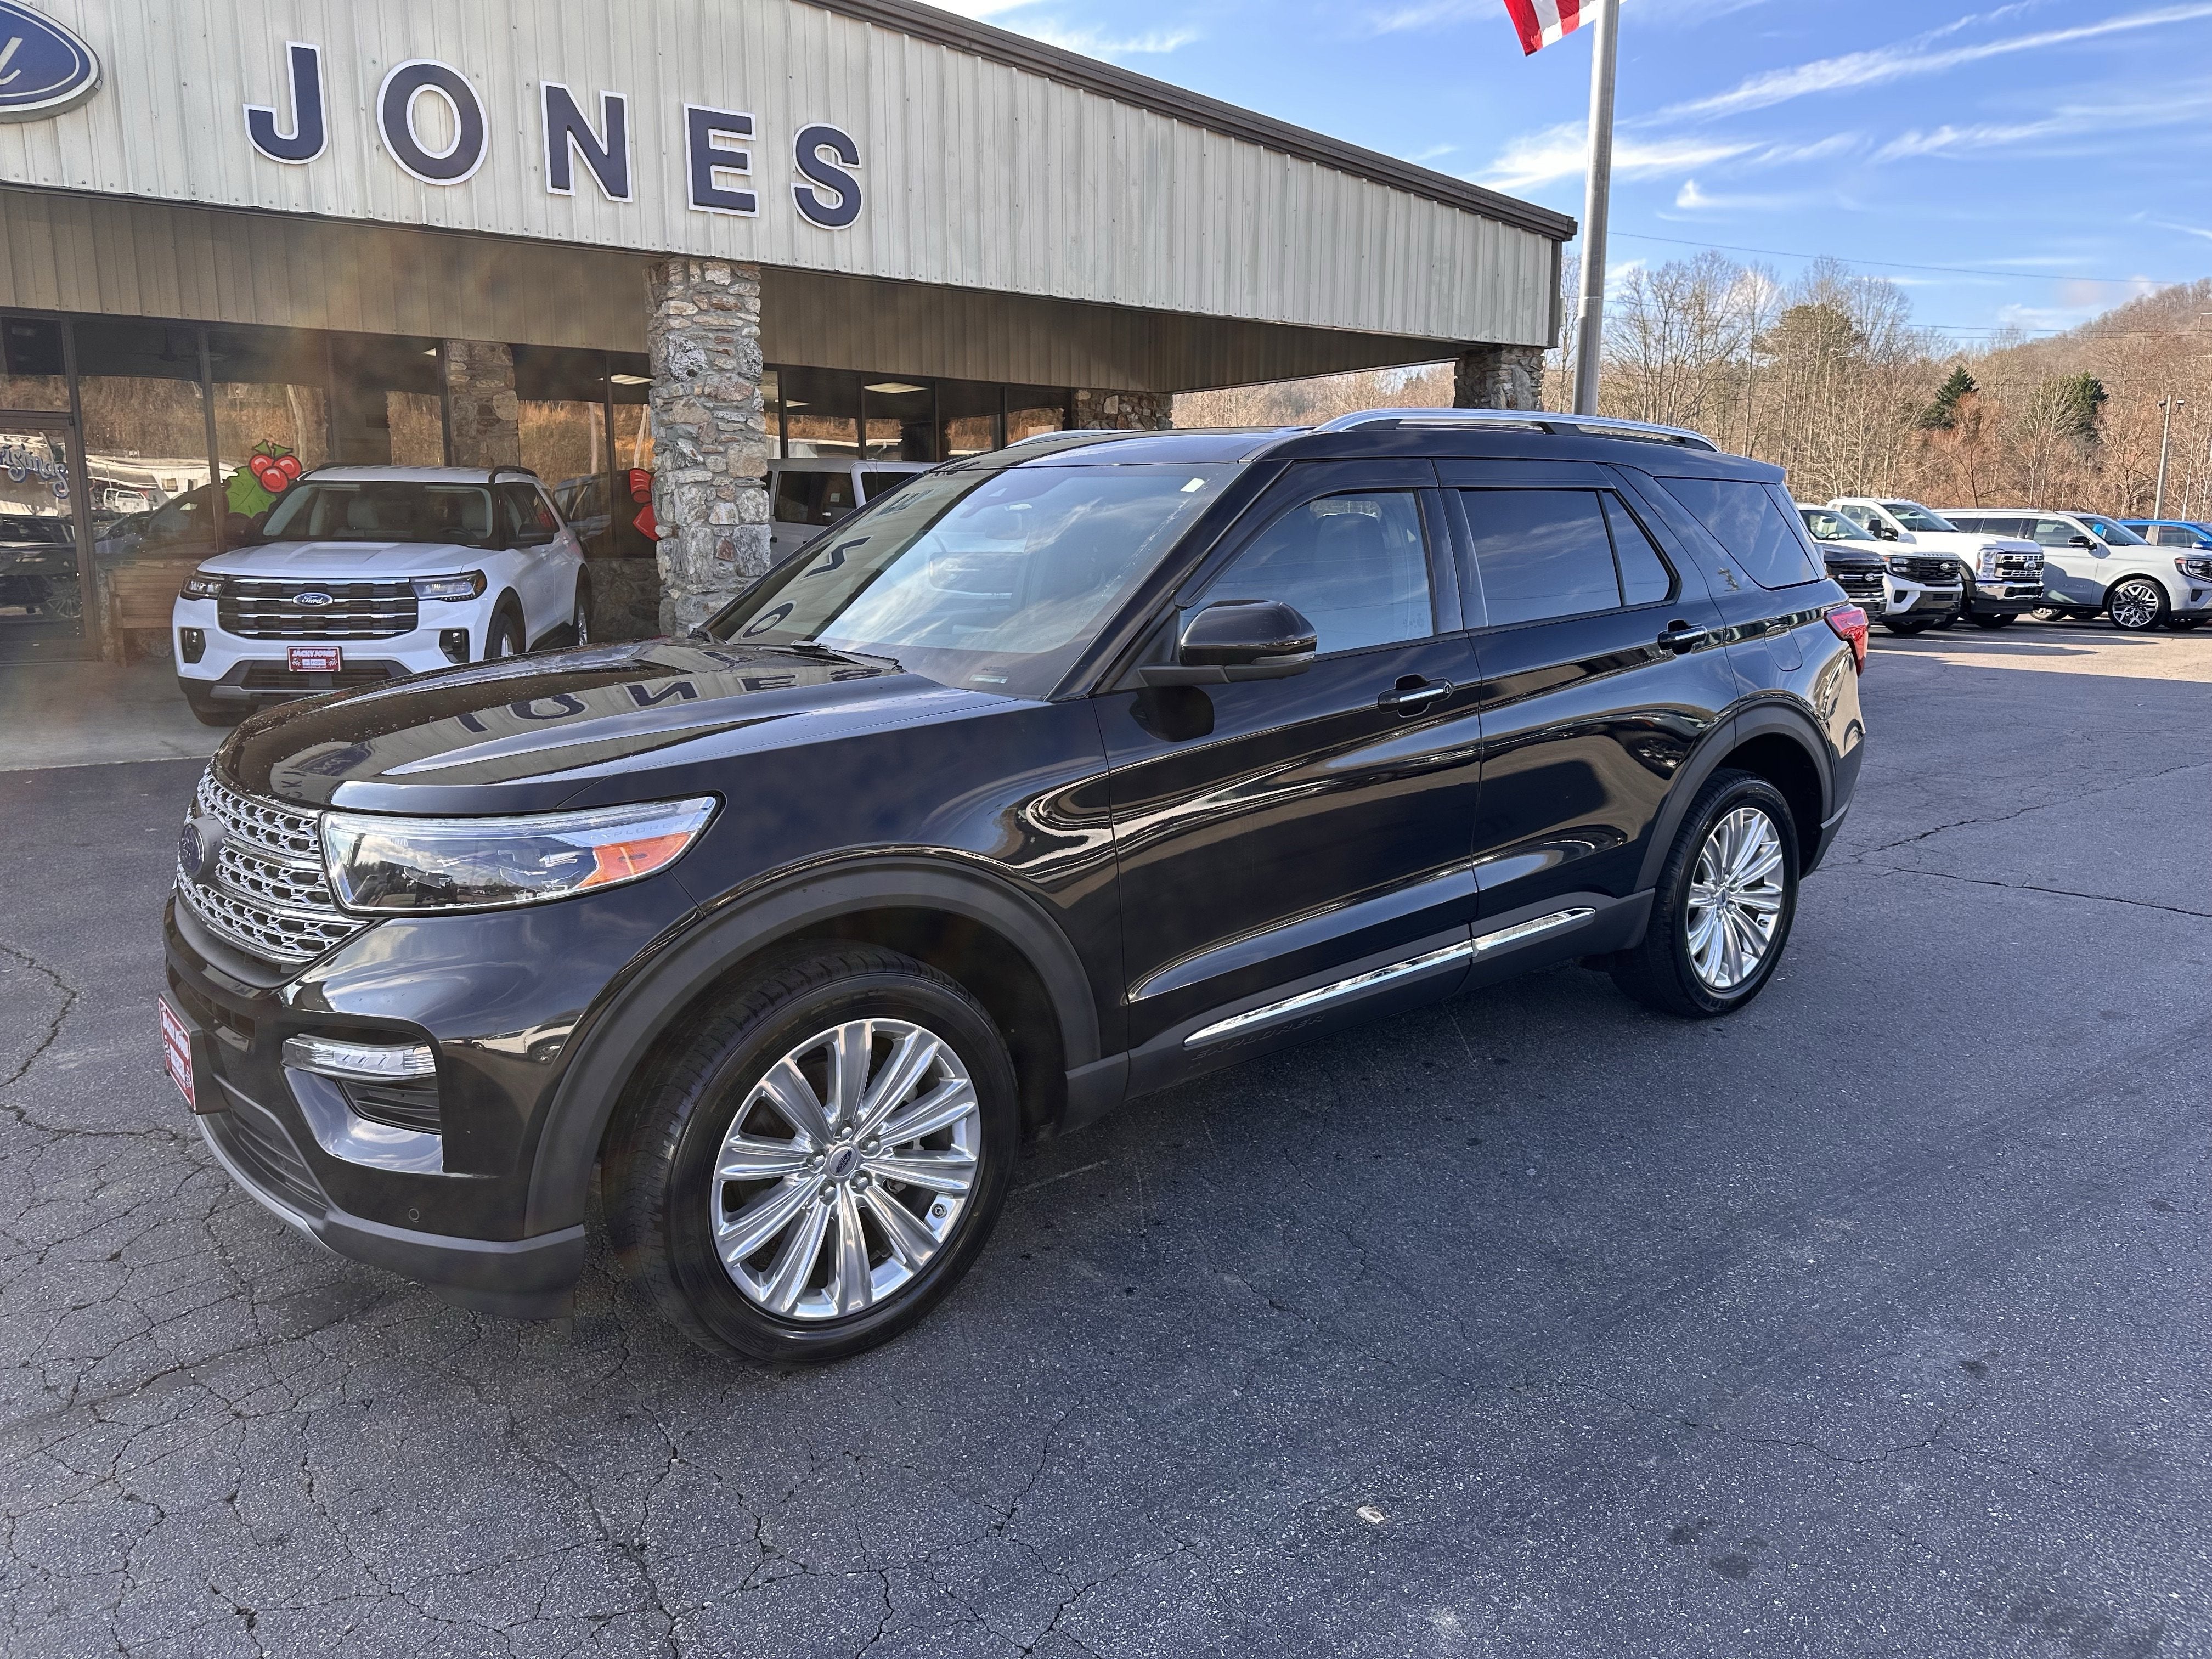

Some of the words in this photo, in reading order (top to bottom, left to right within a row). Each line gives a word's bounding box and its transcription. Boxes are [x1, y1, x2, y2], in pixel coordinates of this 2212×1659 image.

[243, 41, 864, 230] JONES
[301, 595, 324, 604] Ford
[589, 821, 684, 840] EXPLORER
[1191, 1014, 1325, 1061] EXPLORER
